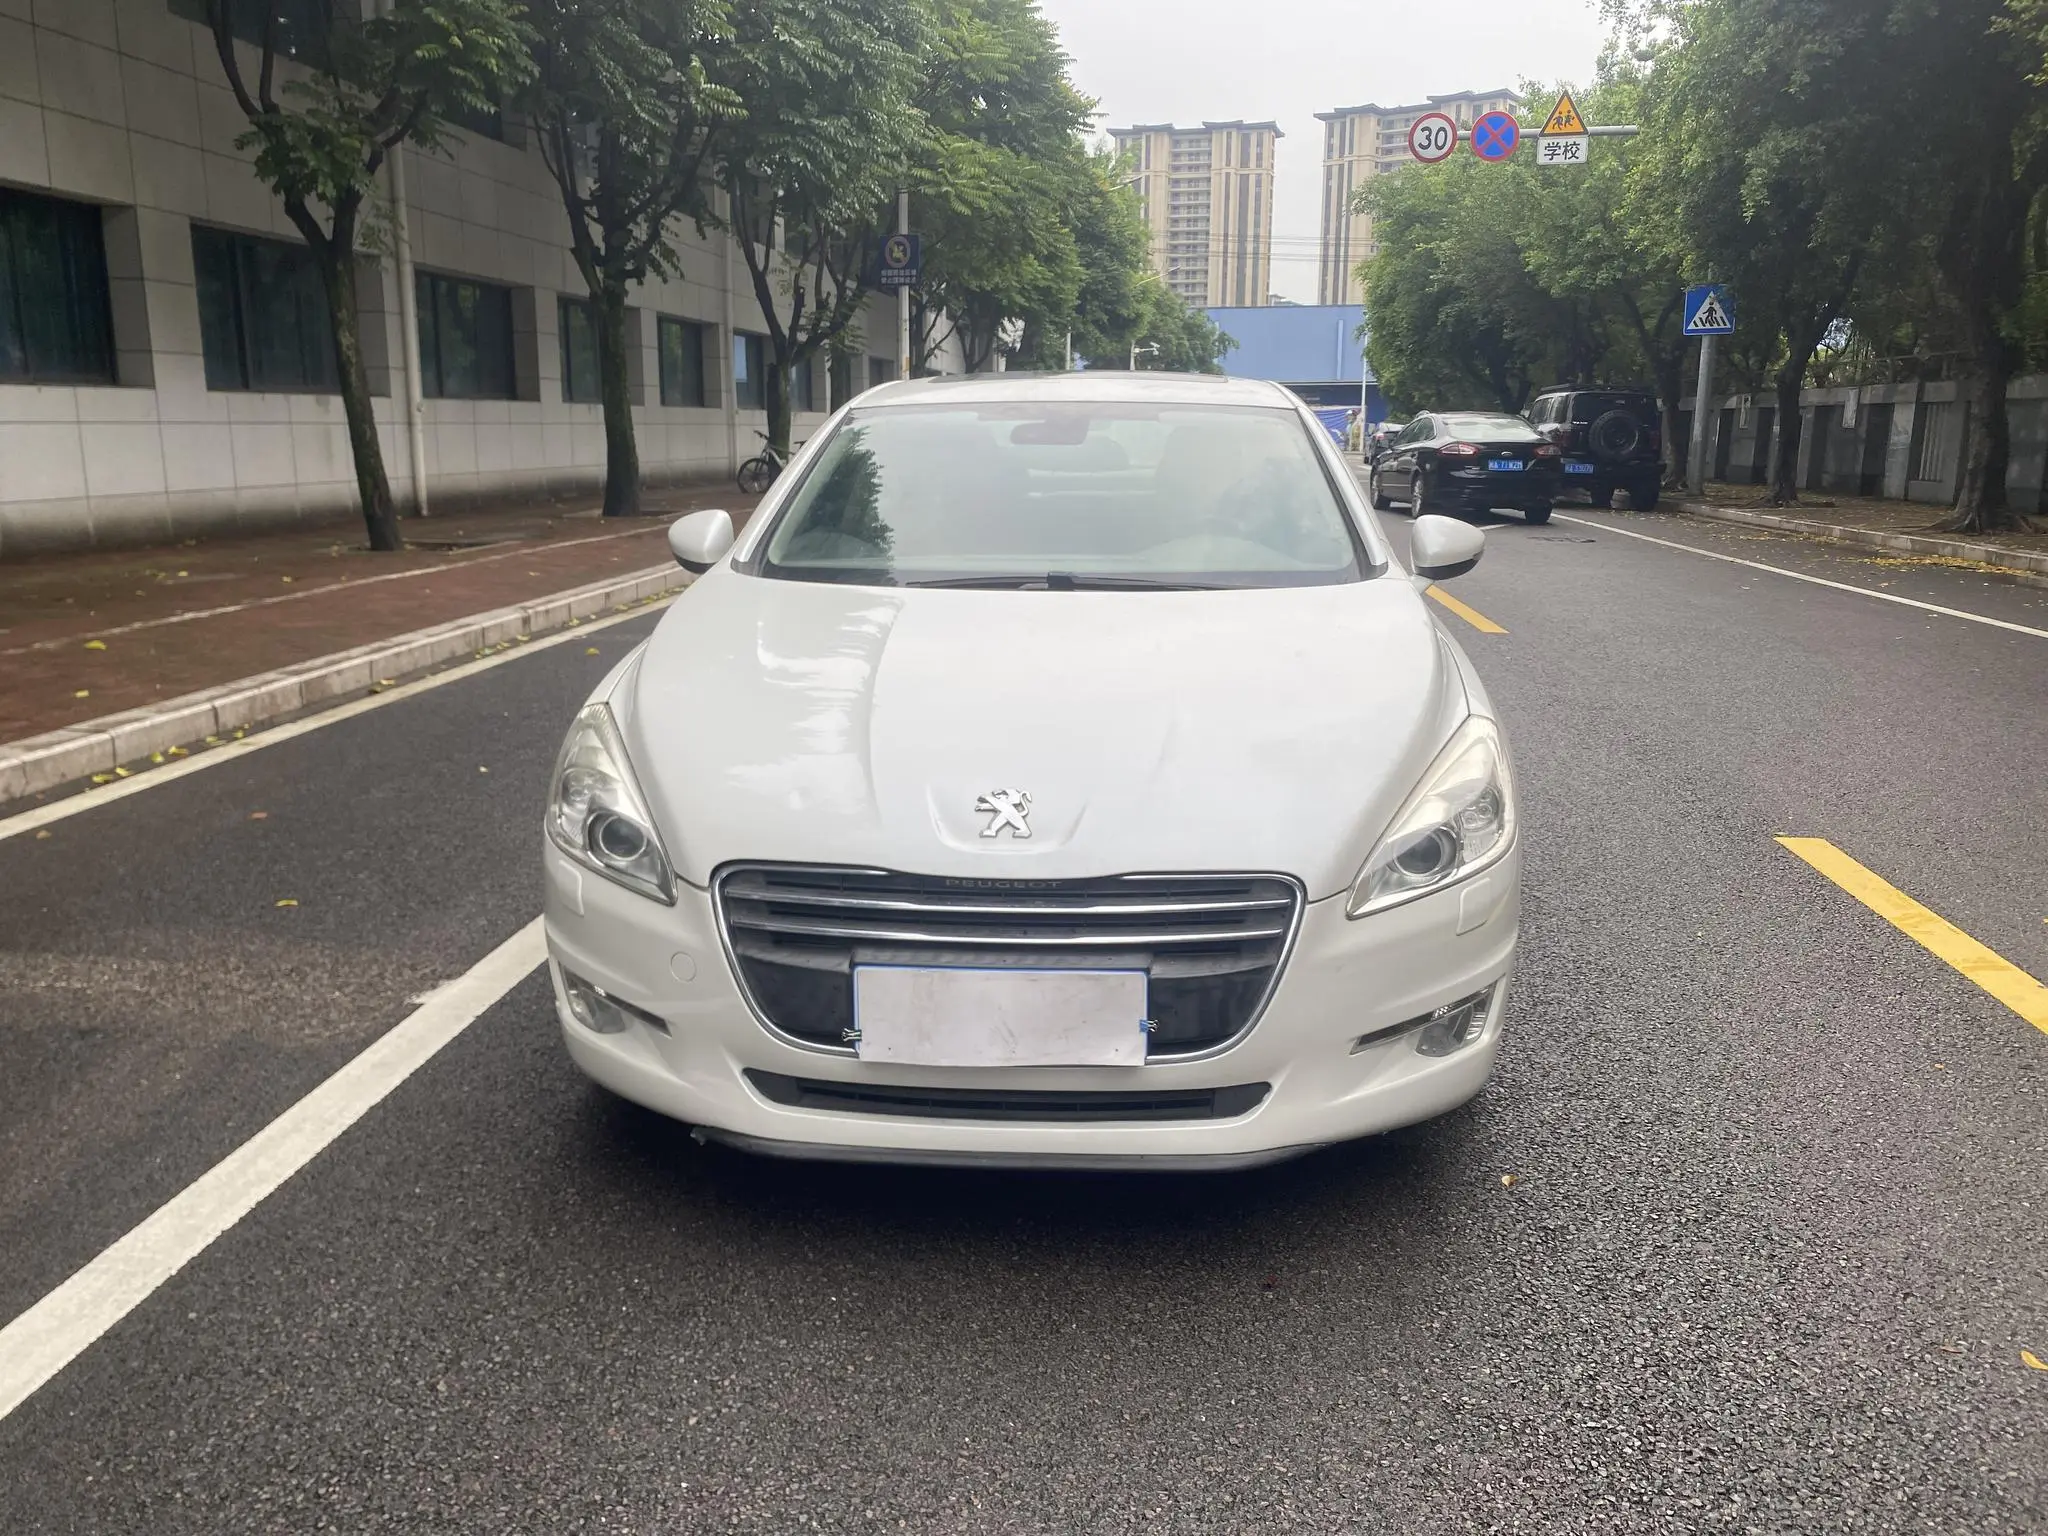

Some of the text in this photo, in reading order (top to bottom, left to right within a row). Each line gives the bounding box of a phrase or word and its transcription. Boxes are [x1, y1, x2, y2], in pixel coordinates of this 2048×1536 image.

[1418, 127, 1448, 150] 30
[1544, 141, 1580, 161] 学校
[945, 879, 1062, 889] PEUGEOT
